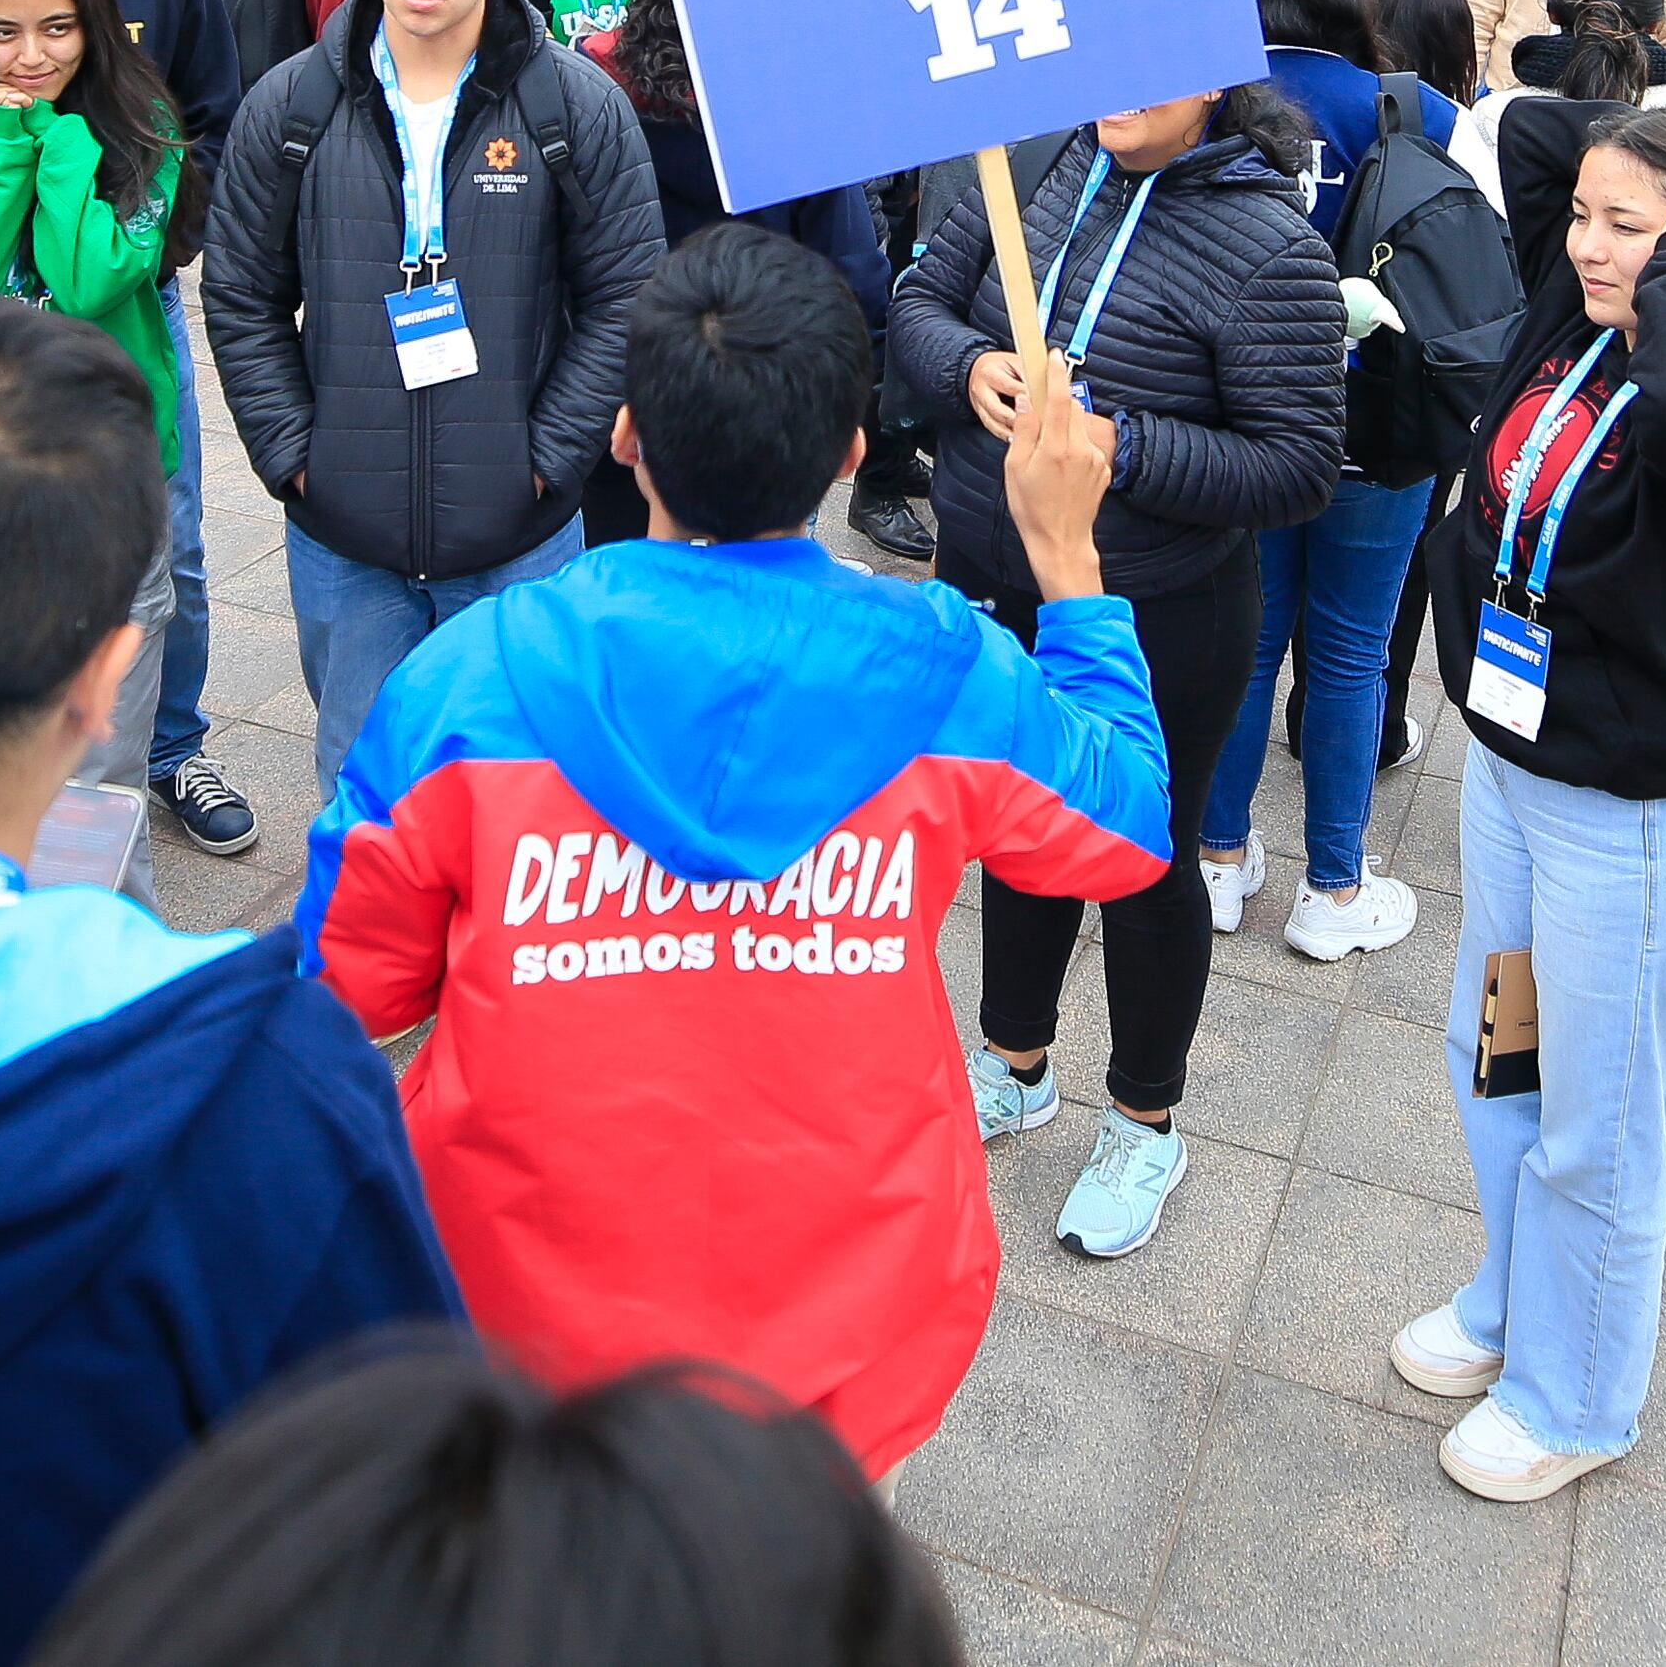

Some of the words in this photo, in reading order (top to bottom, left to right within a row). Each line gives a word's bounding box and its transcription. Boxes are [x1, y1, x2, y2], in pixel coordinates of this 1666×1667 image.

[473, 174, 528, 184] UNIVERSIDAD
[496, 184, 518, 193] LIMA
[1542, 518, 1556, 545] CADE
[1555, 485, 1571, 512] 2024
[512, 931, 715, 985] somos
[732, 922, 907, 975] todos
